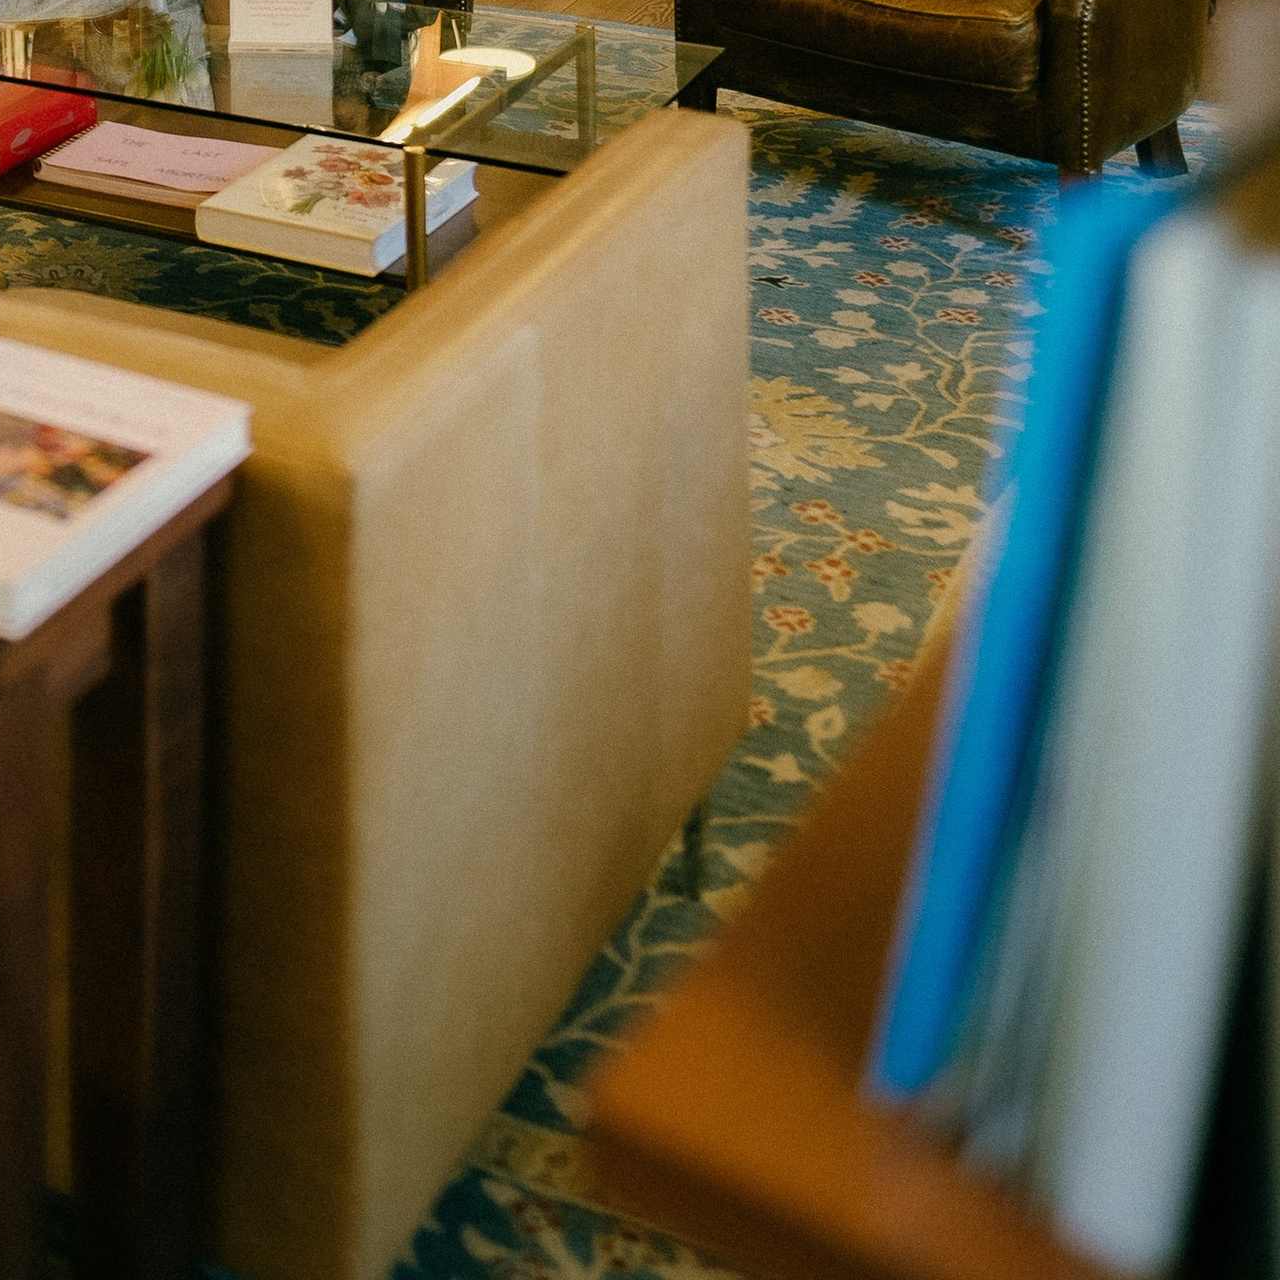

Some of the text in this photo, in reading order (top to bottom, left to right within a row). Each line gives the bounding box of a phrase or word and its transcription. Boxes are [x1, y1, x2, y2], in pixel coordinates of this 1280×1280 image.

[122, 138, 224, 159] THE LAST
[96, 156, 231, 182] SAFE ABORTION
